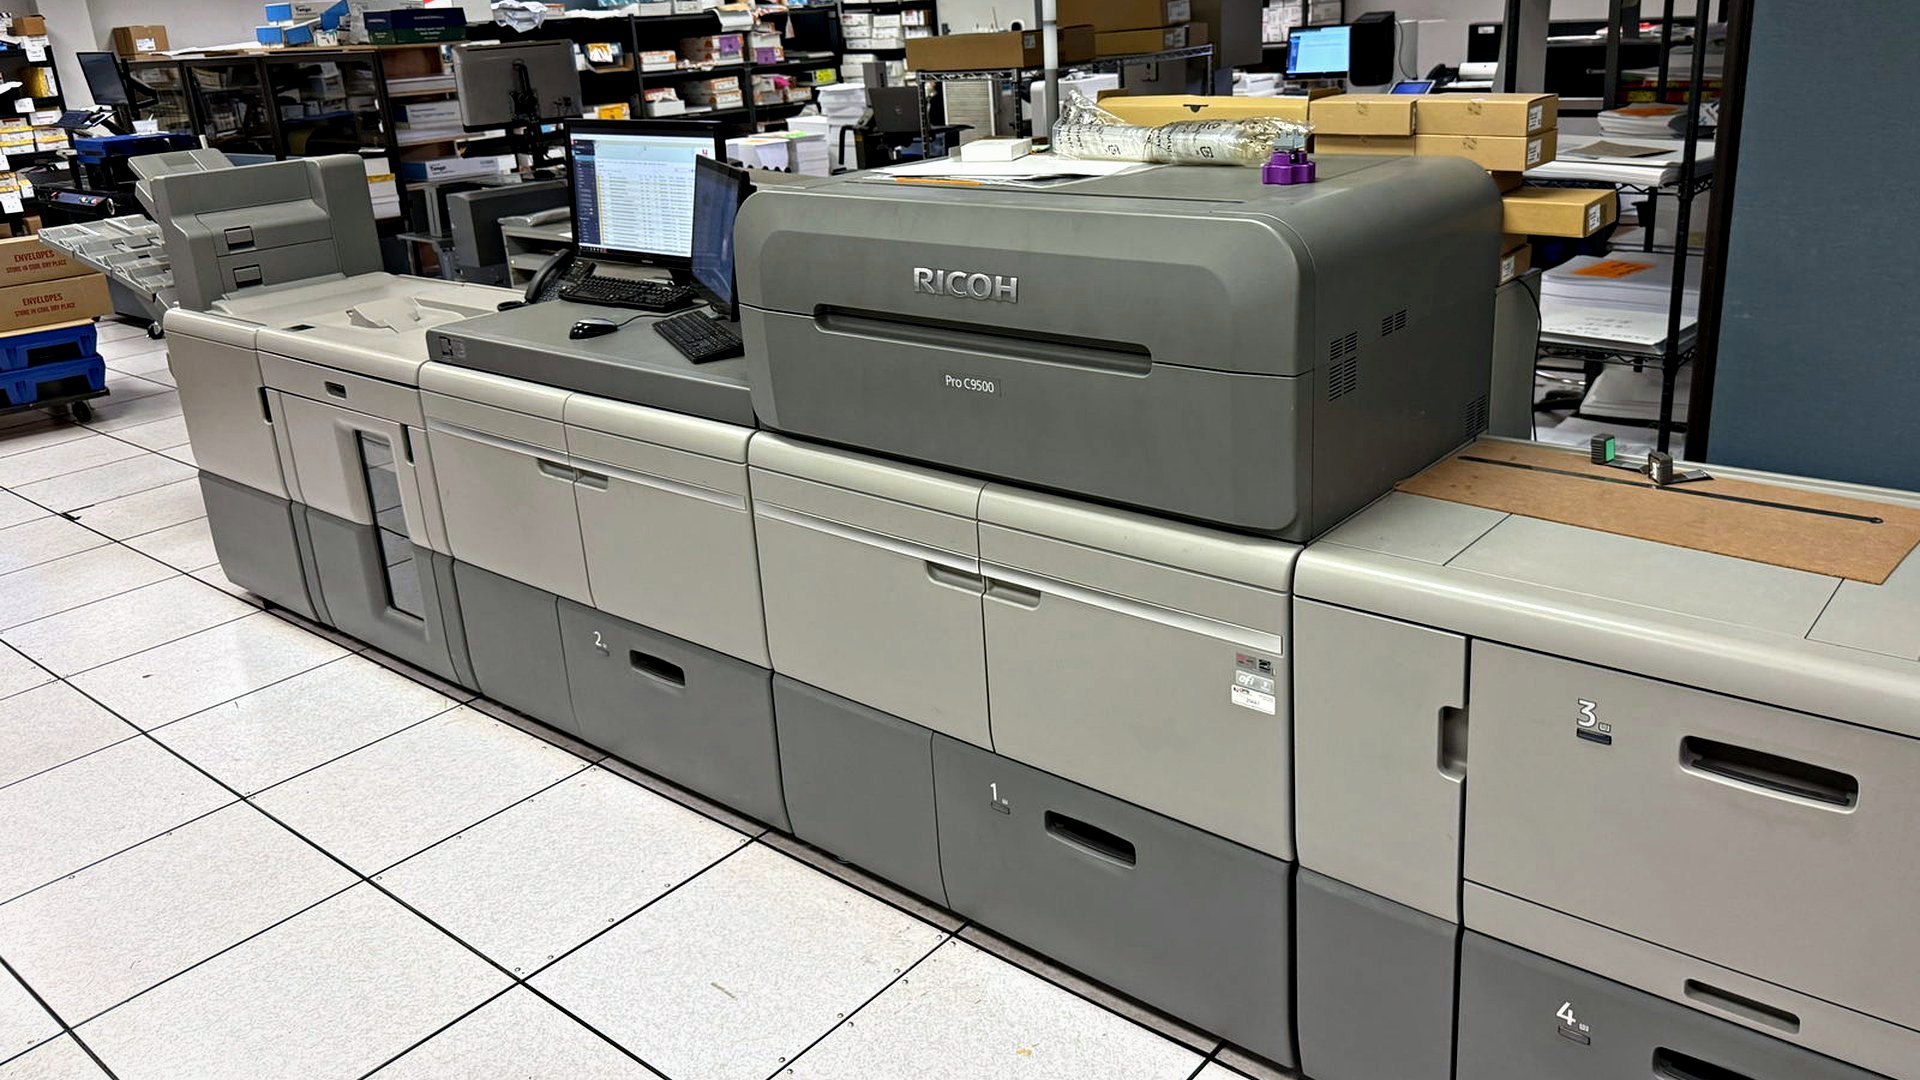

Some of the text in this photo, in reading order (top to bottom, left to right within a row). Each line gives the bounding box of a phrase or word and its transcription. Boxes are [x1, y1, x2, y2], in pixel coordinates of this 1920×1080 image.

[14, 250, 55, 263] ENVELOPES
[913, 267, 1018, 303] RICOH
[22, 292, 64, 306] ENVELOPES
[61, 302, 76, 310] PLACE
[944, 374, 994, 393] Pro C9500
[593, 630, 602, 647] 2
[1577, 698, 1597, 728] 3
[990, 782, 998, 801] 1
[1556, 1001, 1577, 1026] 4
